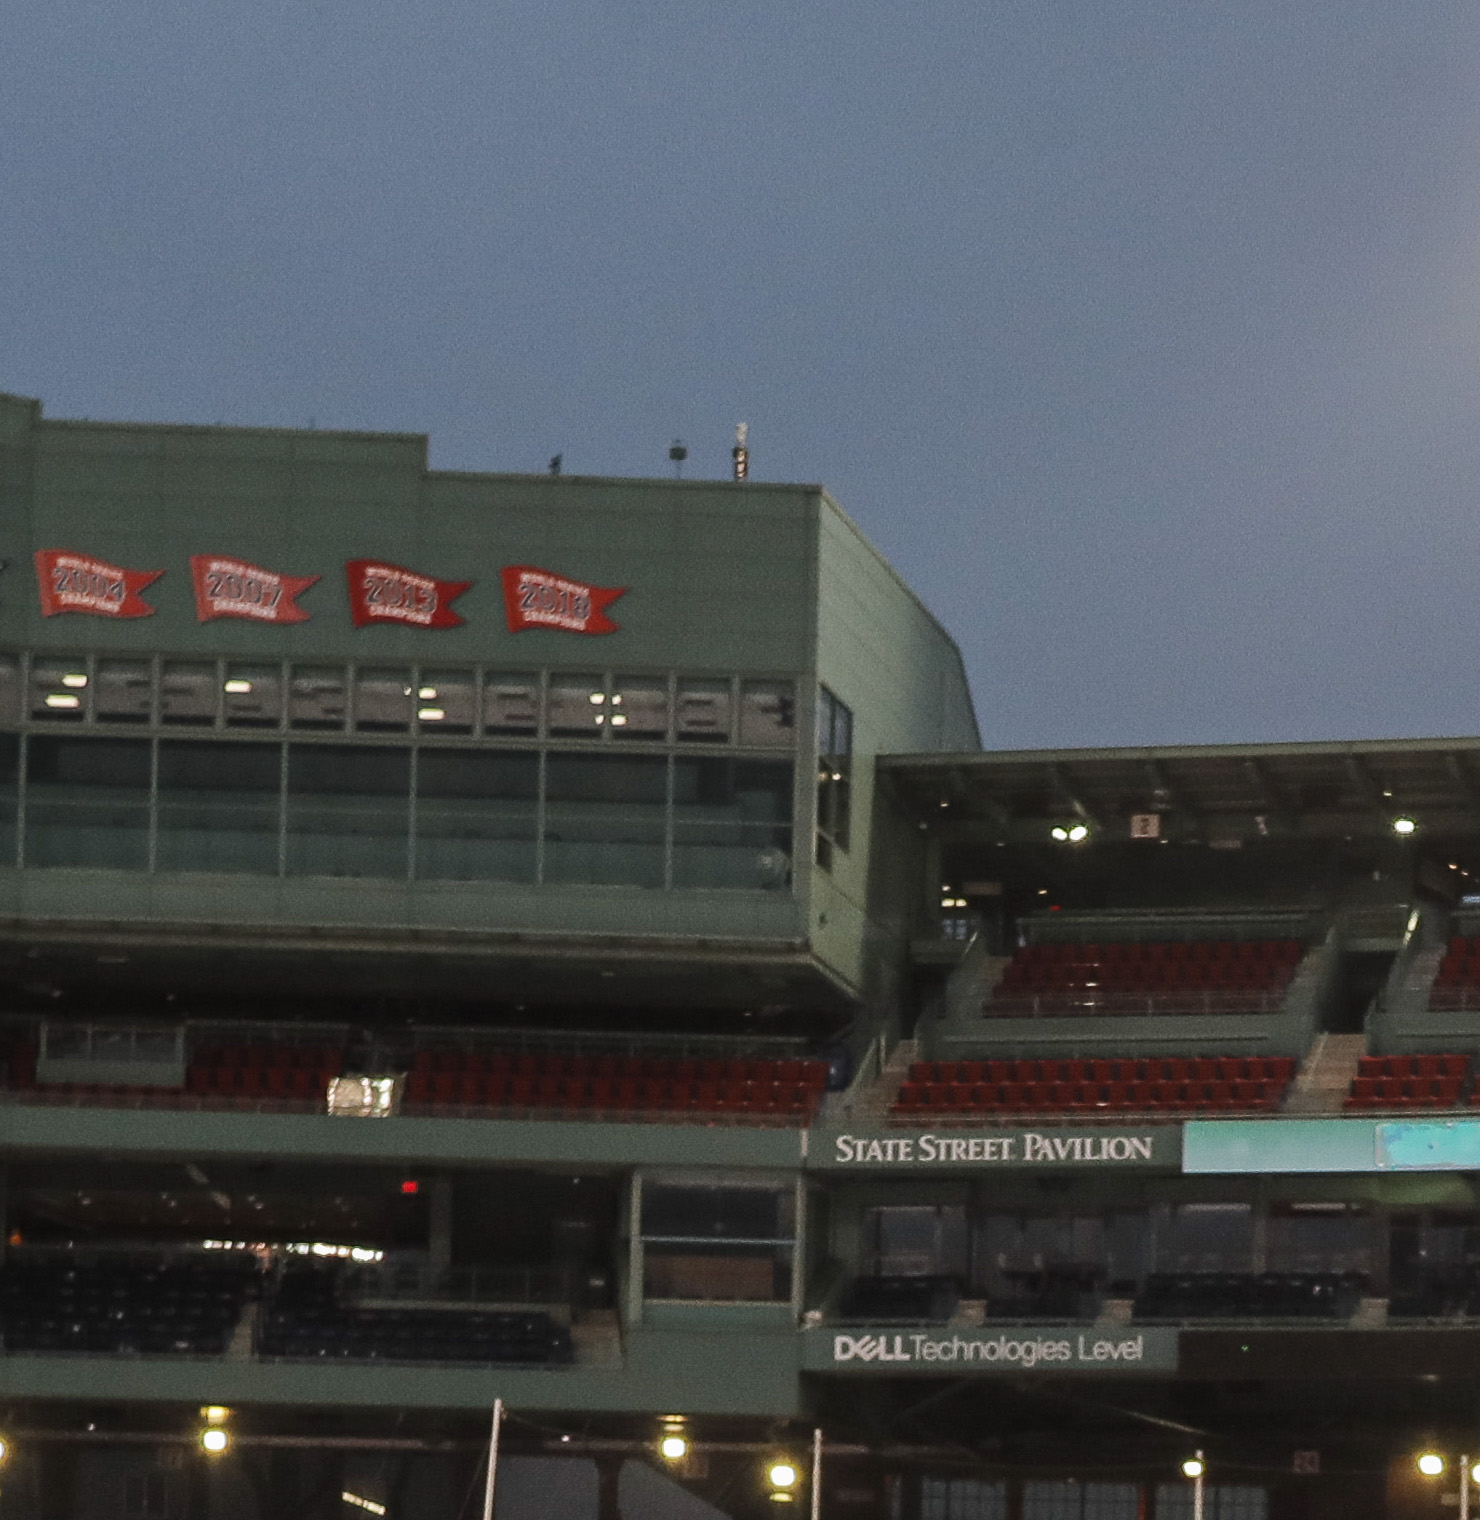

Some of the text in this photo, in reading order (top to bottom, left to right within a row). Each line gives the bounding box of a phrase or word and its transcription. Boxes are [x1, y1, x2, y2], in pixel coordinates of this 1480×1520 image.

[53, 567, 126, 602] 2004
[207, 571, 283, 609] 2007
[363, 577, 438, 613] 2013
[519, 582, 591, 620] 2018
[836, 1134, 1154, 1162] STATE STREET PAVILION
[1078, 1334, 1144, 1361] Level
